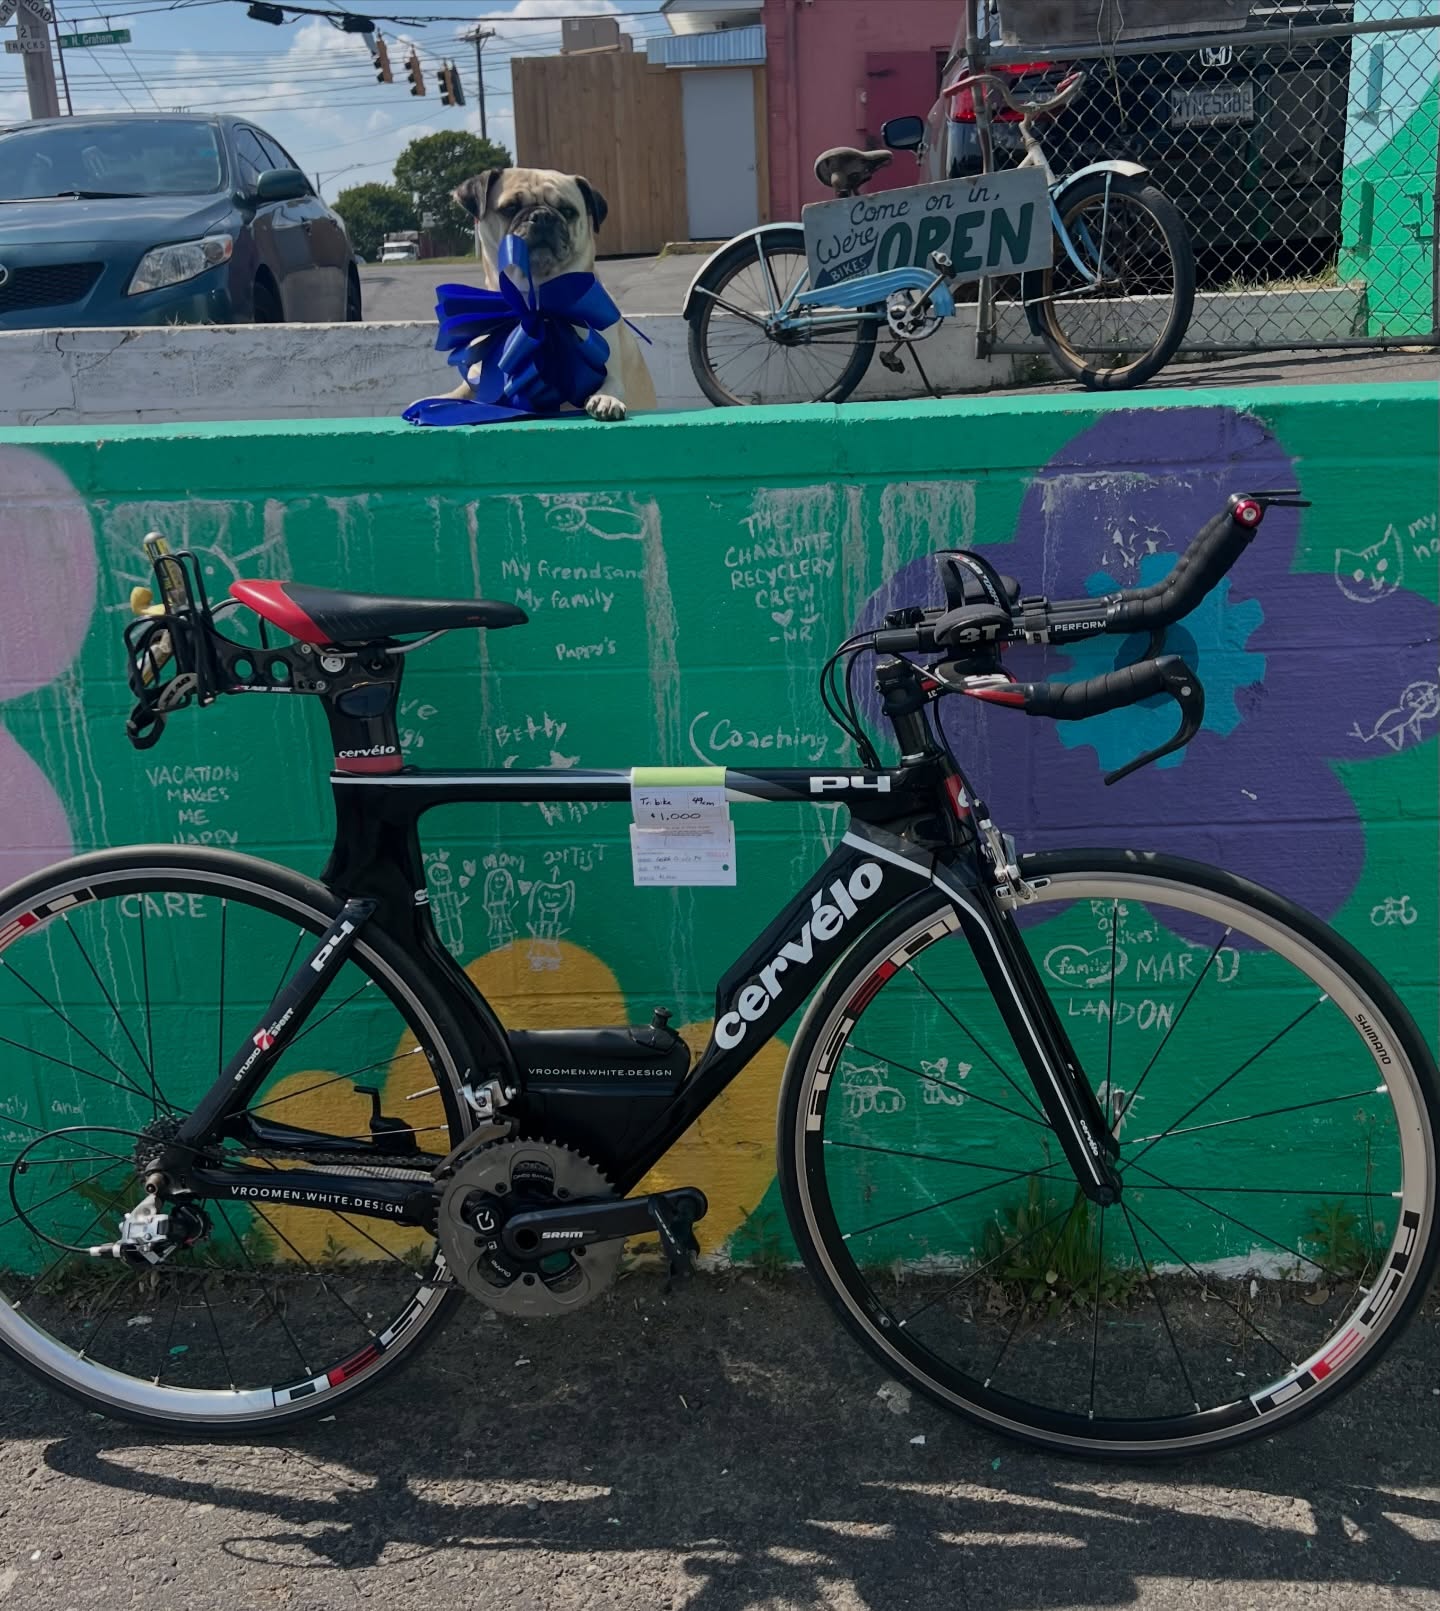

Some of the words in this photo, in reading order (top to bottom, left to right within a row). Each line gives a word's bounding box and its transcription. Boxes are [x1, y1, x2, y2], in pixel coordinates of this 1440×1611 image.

[25, 0, 51, 21] ROAD
[7, 40, 45, 50] TRACKS
[20, 27, 27, 38] 2
[82, 34, 114, 45] Graham
[850, 200, 911, 226] Come
[925, 192, 955, 212] on
[967, 183, 1001, 203] in,
[816, 226, 879, 265] We're
[877, 201, 1035, 274] OPEN
[830, 257, 867, 282] BIKES
[738, 508, 791, 538] THE
[724, 531, 833, 568] CHARLOTTE
[502, 557, 531, 582] My
[730, 557, 836, 591] RECYCLERY
[515, 587, 544, 612] My
[551, 586, 615, 613] family
[755, 582, 815, 609] CREW
[959, 623, 1001, 643] 3T
[1054, 620, 1107, 632] PERFORM
[338, 744, 396, 758] cervélo
[145, 765, 239, 787] VACATION
[809, 775, 891, 793] P4
[167, 786, 230, 803] MAKES
[178, 808, 211, 826] ME
[120, 892, 207, 919] CARE
[310, 920, 355, 973] P4
[714, 862, 884, 1051] cervélo
[1068, 997, 1176, 1031] LANDON
[234, 1047, 262, 1082] STUDIO
[270, 1007, 295, 1037] SPORT
[1354, 1013, 1392, 1066] SHIMANO
[541, 1230, 584, 1240] SRAM
